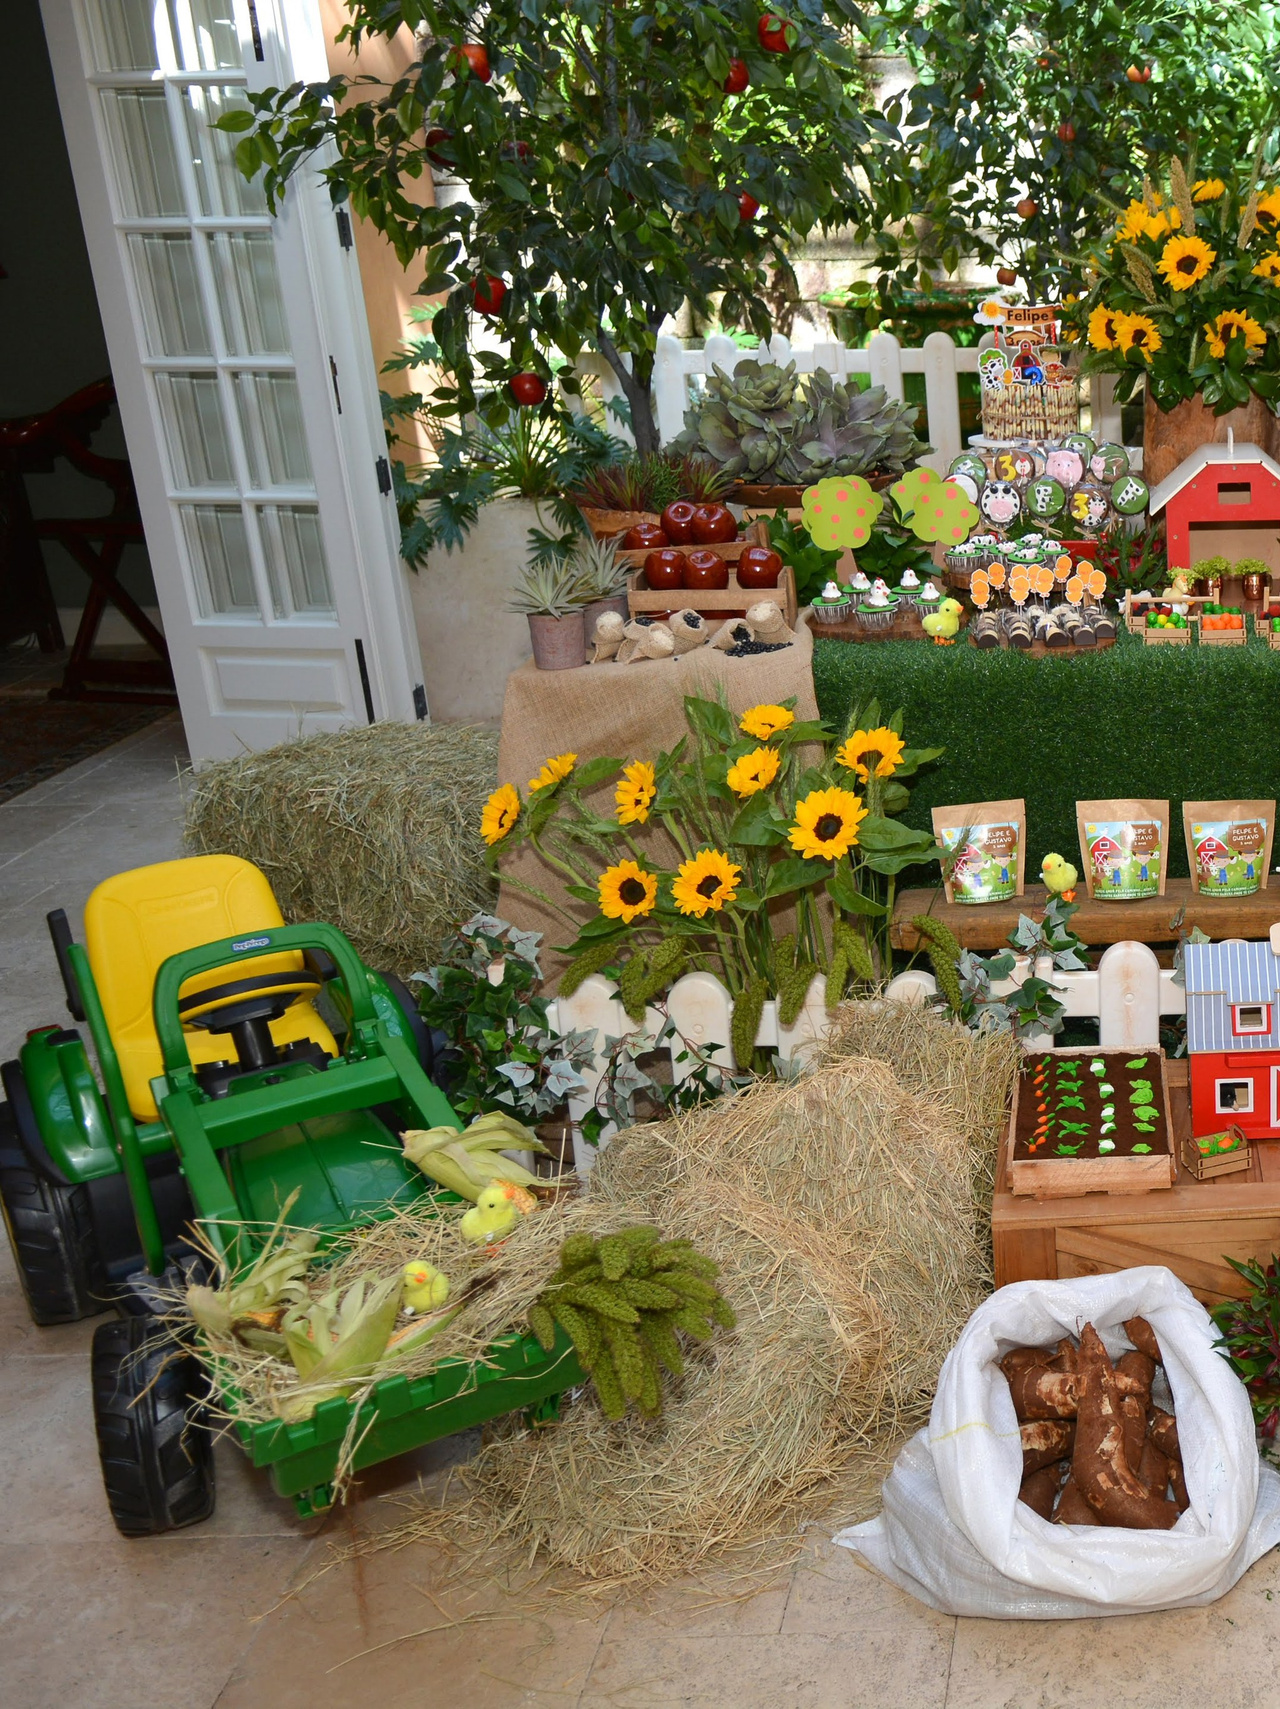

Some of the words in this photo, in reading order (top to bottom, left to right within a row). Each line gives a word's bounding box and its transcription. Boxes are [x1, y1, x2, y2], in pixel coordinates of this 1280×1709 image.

[1007, 309, 1049, 324] Felipe
[999, 455, 1017, 481] 3
[1035, 486, 1052, 512] F
[1072, 493, 1089, 519] 3
[1232, 834, 1259, 842] GUSTAVO
